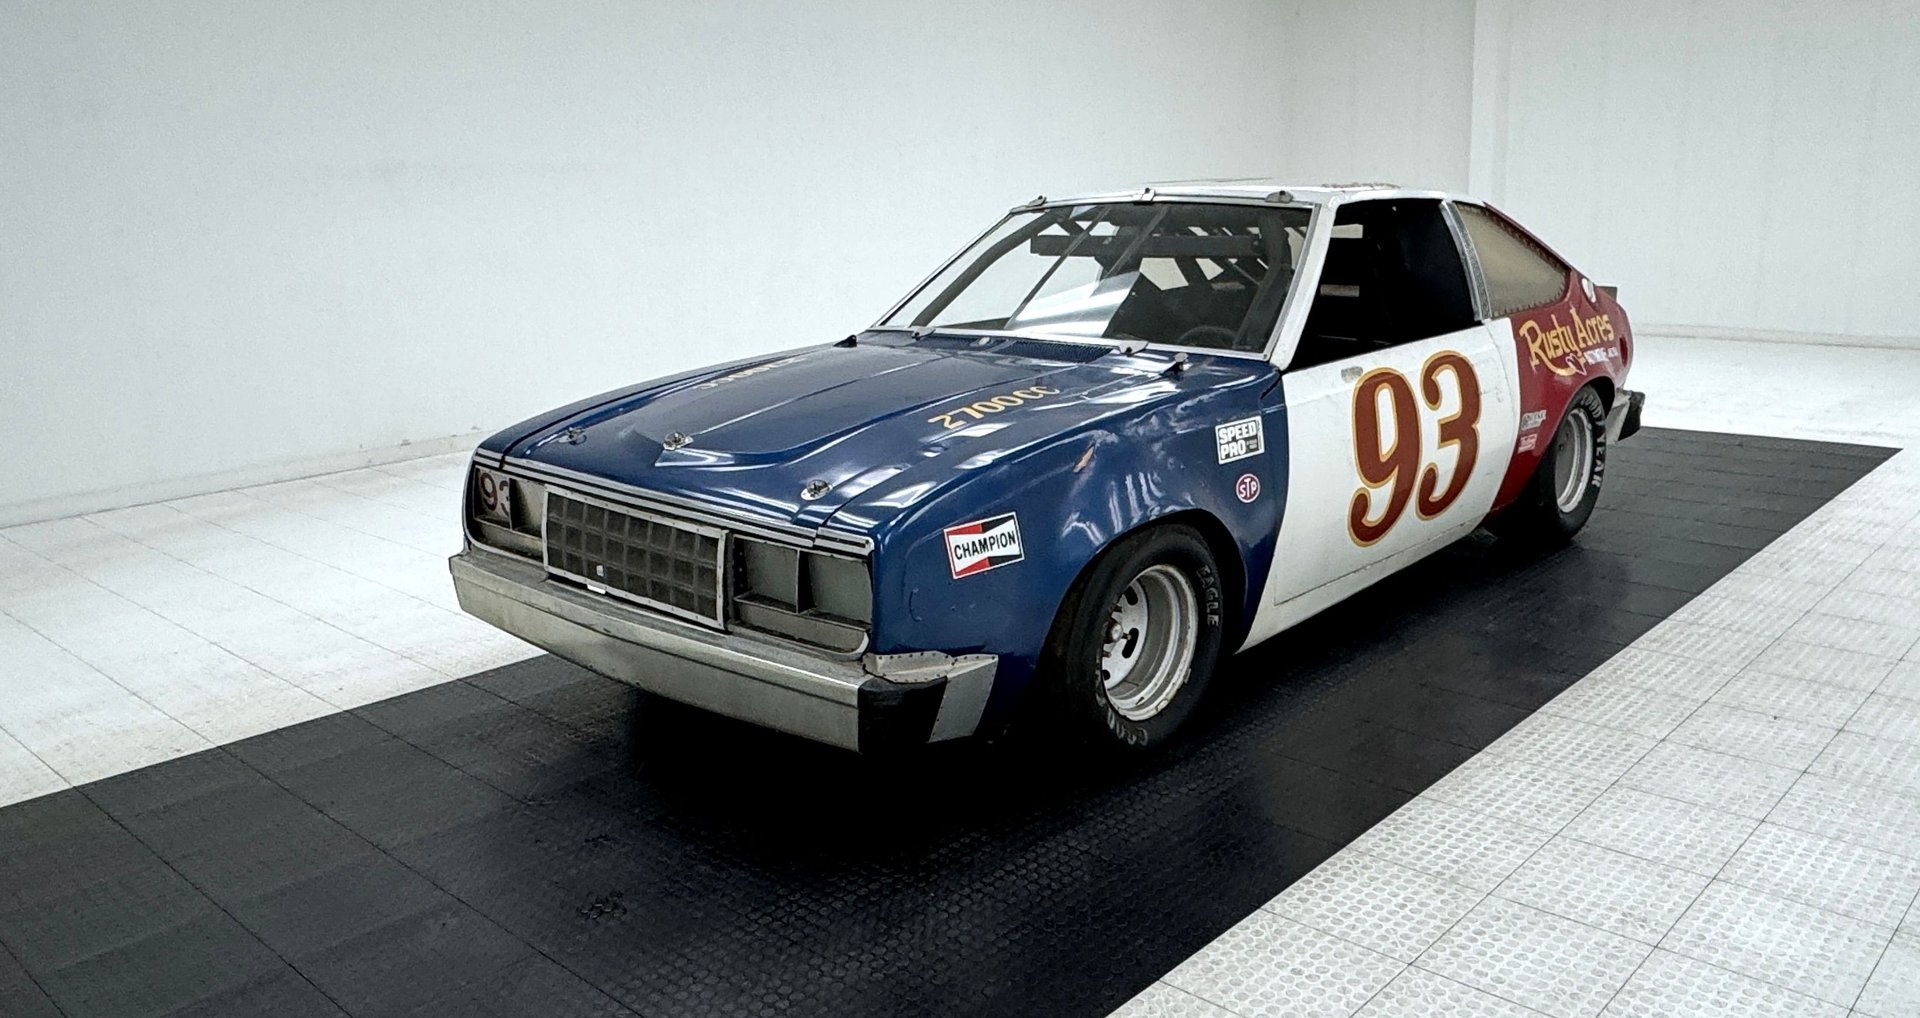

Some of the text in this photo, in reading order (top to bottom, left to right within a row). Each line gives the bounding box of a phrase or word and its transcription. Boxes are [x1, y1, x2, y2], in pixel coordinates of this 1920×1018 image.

[1519, 301, 1615, 375] Rusty Acres
[927, 386, 1060, 429] 2700CC
[1218, 421, 1257, 444] SPEED
[1220, 439, 1247, 460] PRO
[1347, 349, 1482, 548] 93
[1239, 477, 1258, 498] STP
[953, 530, 1017, 560] CHAMPION
[1197, 565, 1220, 627] EAGLE
